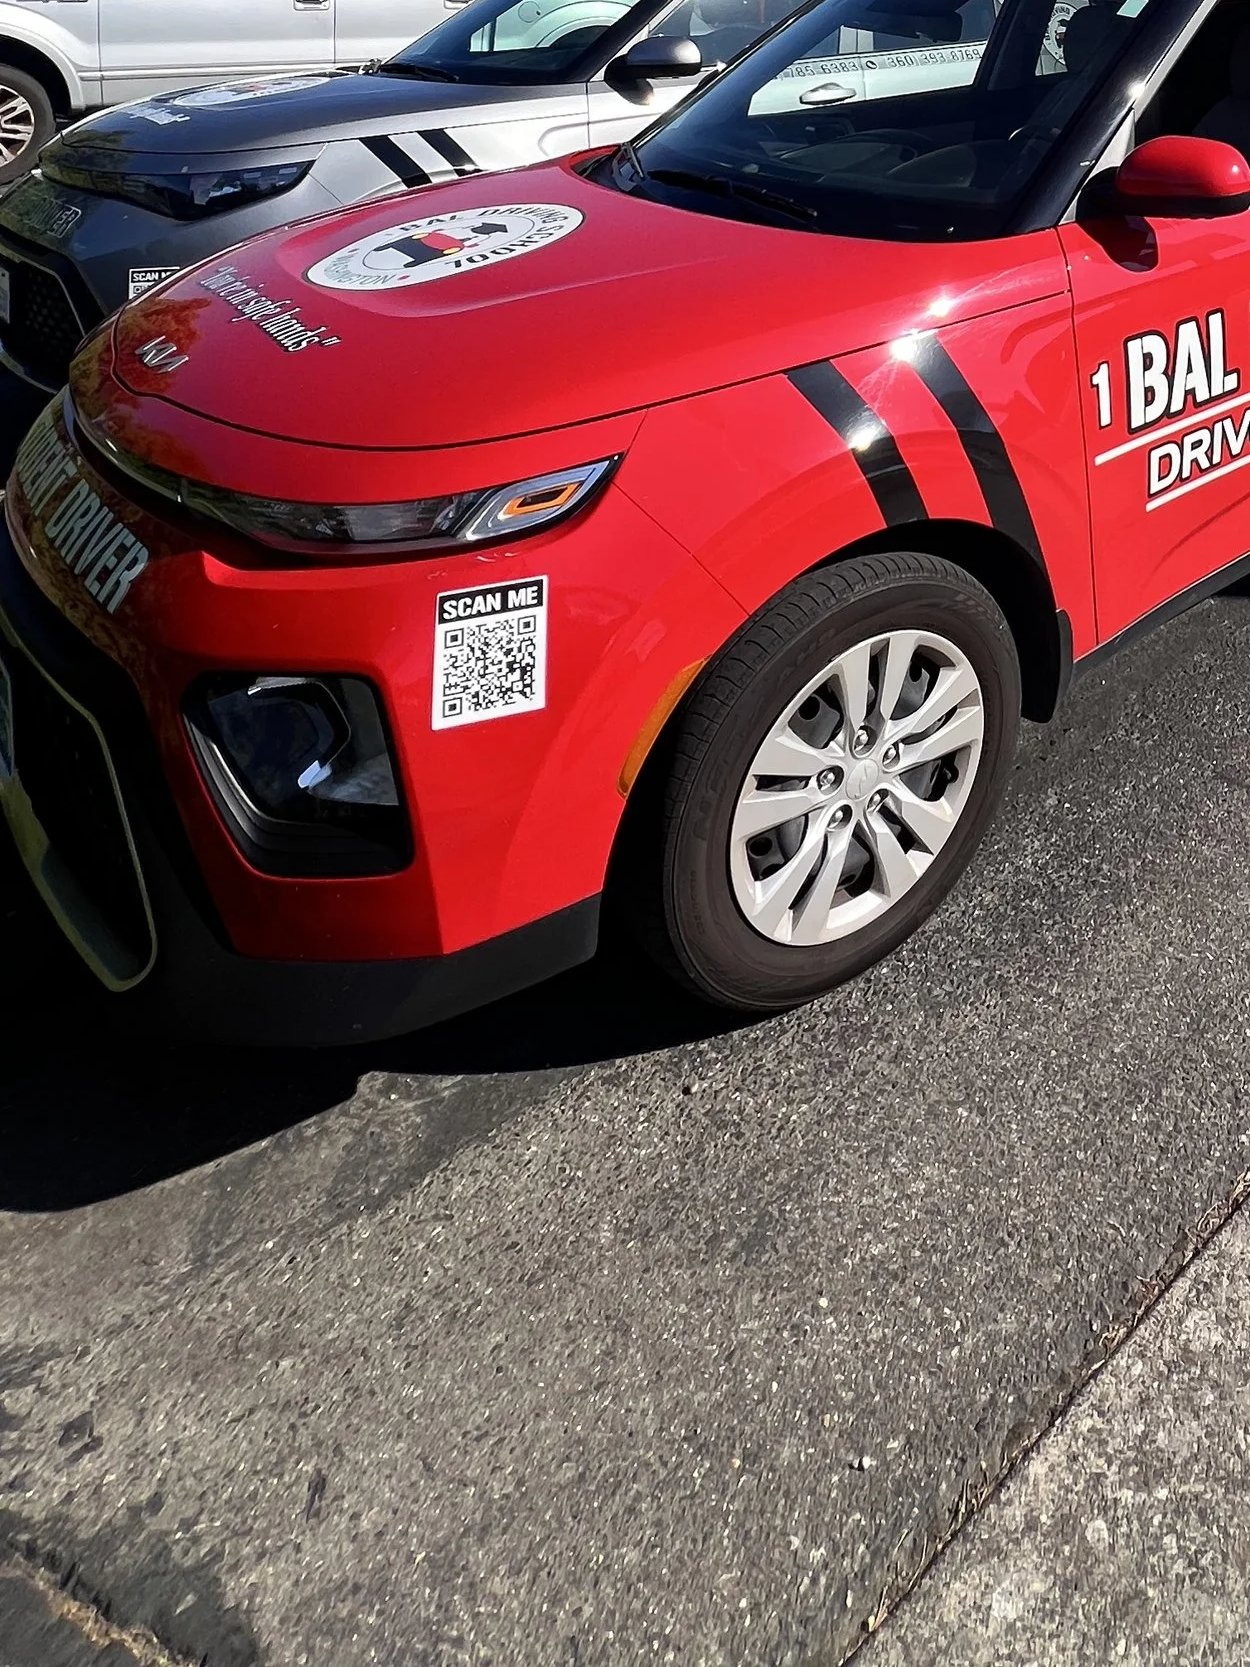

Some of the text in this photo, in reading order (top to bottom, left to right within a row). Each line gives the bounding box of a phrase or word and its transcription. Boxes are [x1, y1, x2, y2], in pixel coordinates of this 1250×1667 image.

[400, 206, 569, 268] BAL DRIVING SCHOOL
[132, 272, 158, 281] SCAN
[1091, 361, 1112, 428] 1
[1125, 308, 1240, 433] BAL
[45, 478, 149, 614] DRIVER
[443, 585, 539, 620] SCAN ME
